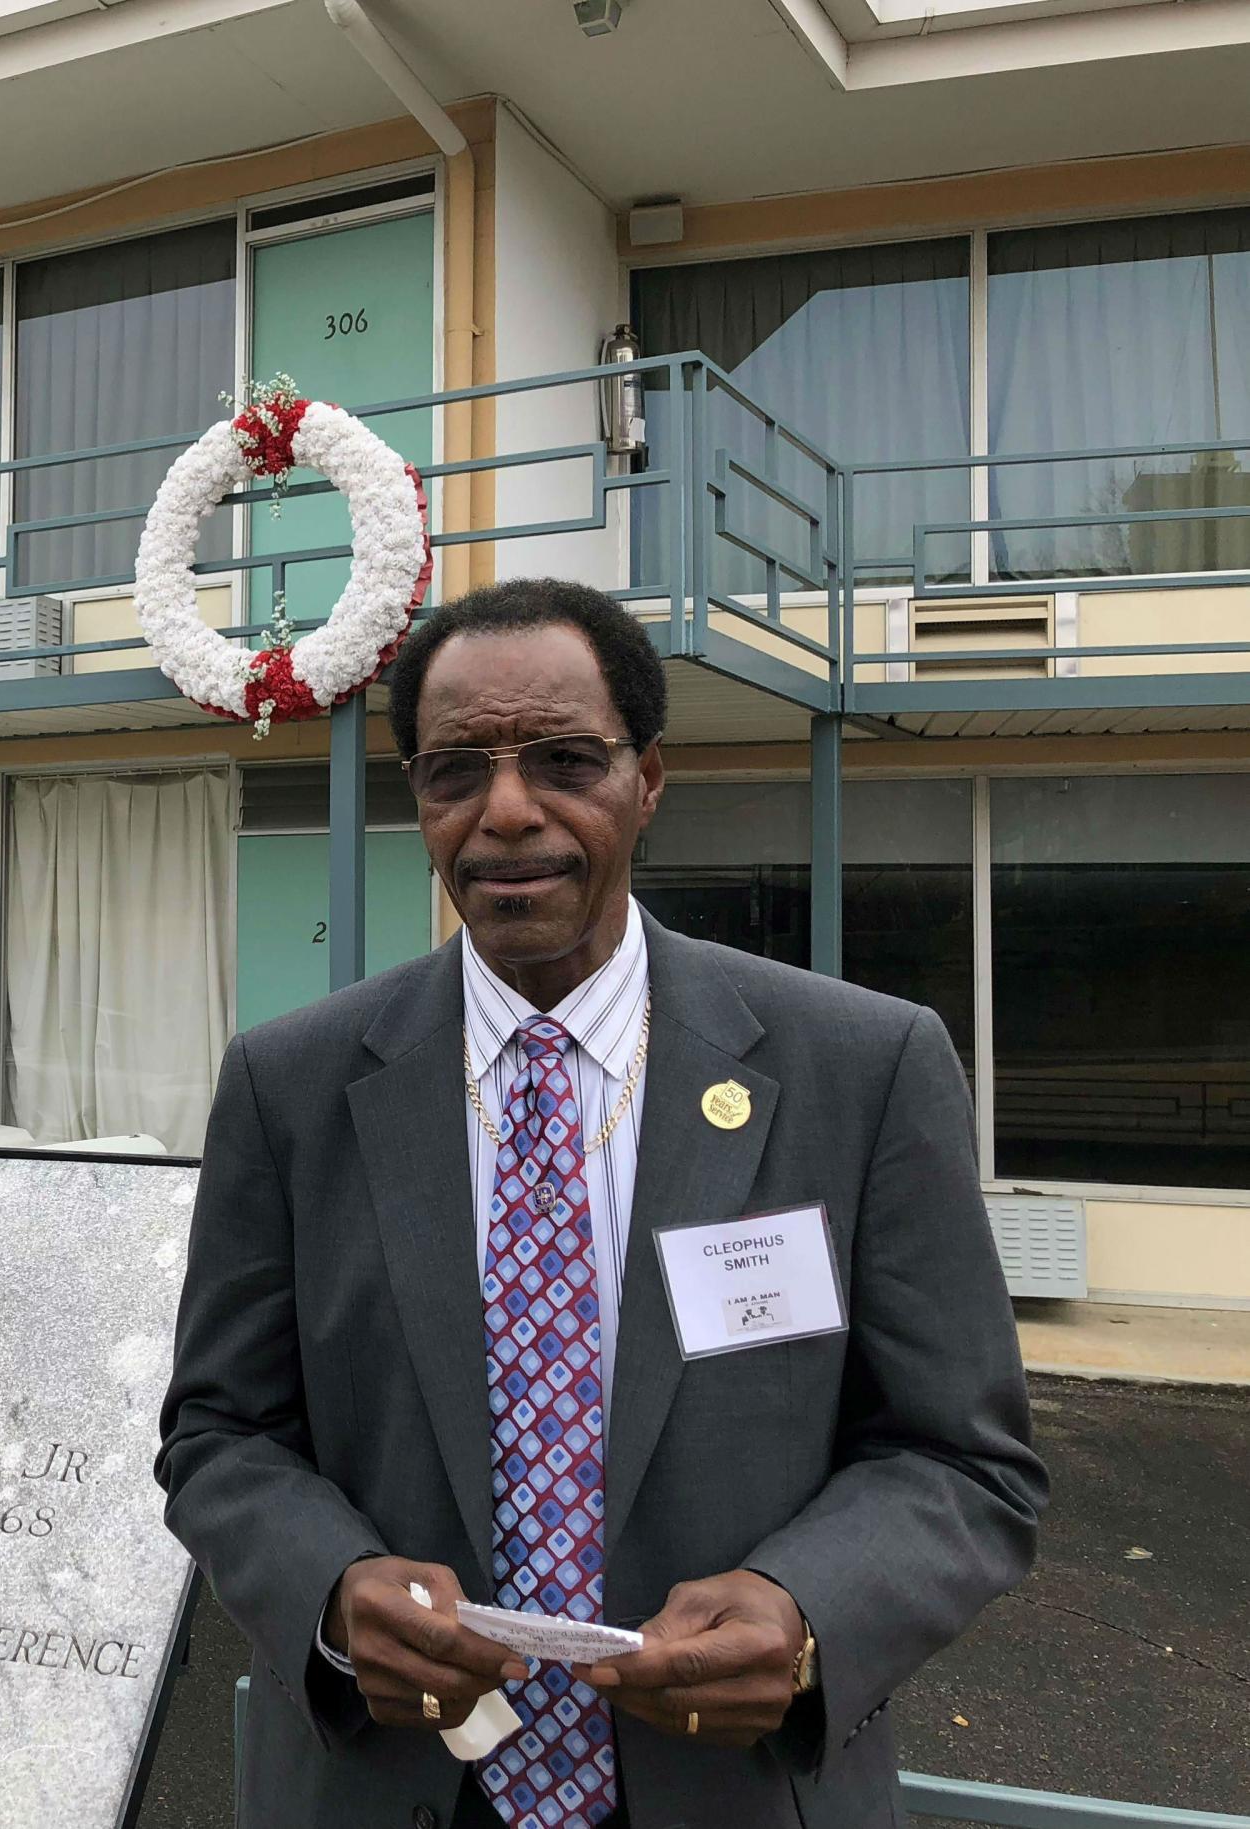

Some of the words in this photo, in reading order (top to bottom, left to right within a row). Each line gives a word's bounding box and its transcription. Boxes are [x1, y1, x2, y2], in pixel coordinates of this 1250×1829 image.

[324, 307, 368, 340] 306
[724, 1086, 744, 1104] 50
[703, 1234, 785, 1258] CLEOPHUS
[724, 1254, 770, 1271] SMITH
[734, 1297, 748, 1305] AM
[760, 1291, 781, 1300] MAN
